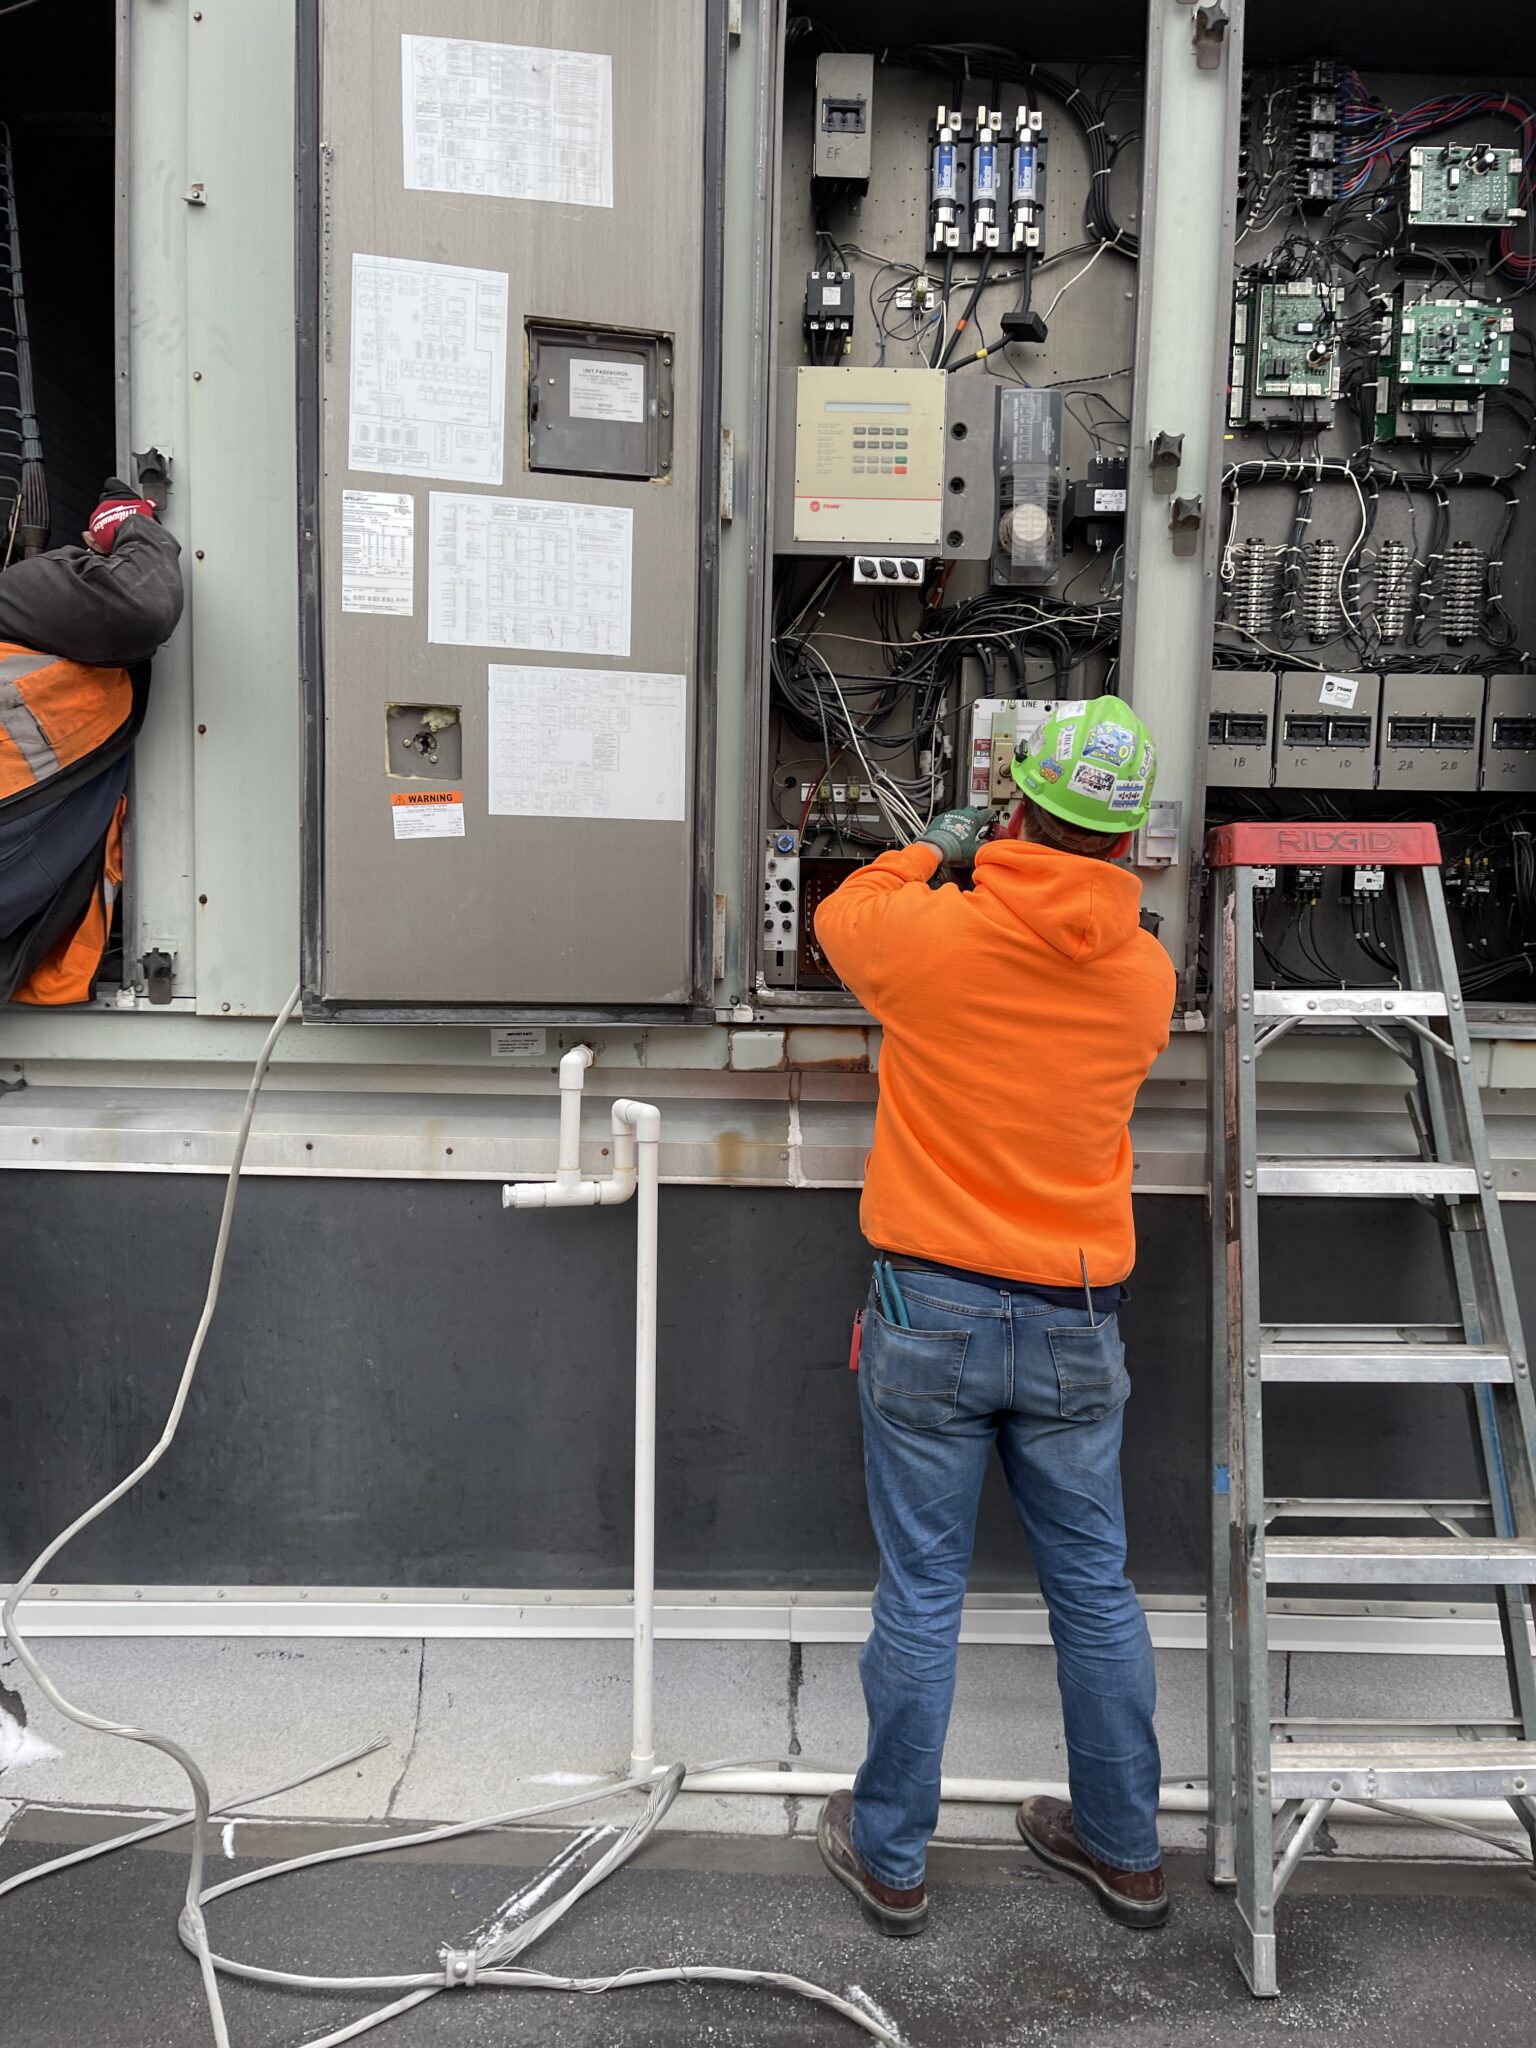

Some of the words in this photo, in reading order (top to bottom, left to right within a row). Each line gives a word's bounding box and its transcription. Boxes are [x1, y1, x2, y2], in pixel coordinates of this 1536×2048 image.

[826, 146, 841, 161] EF
[1233, 758, 1246, 768] 1B
[1295, 758, 1308, 767] 1C
[1339, 759, 1352, 769] 1D
[1398, 760, 1414, 772] 2A
[1440, 761, 1459, 771] 2B
[1502, 763, 1517, 774] 2C
[408, 793, 453, 803] WARNING
[1278, 830, 1395, 852] RIDGID
